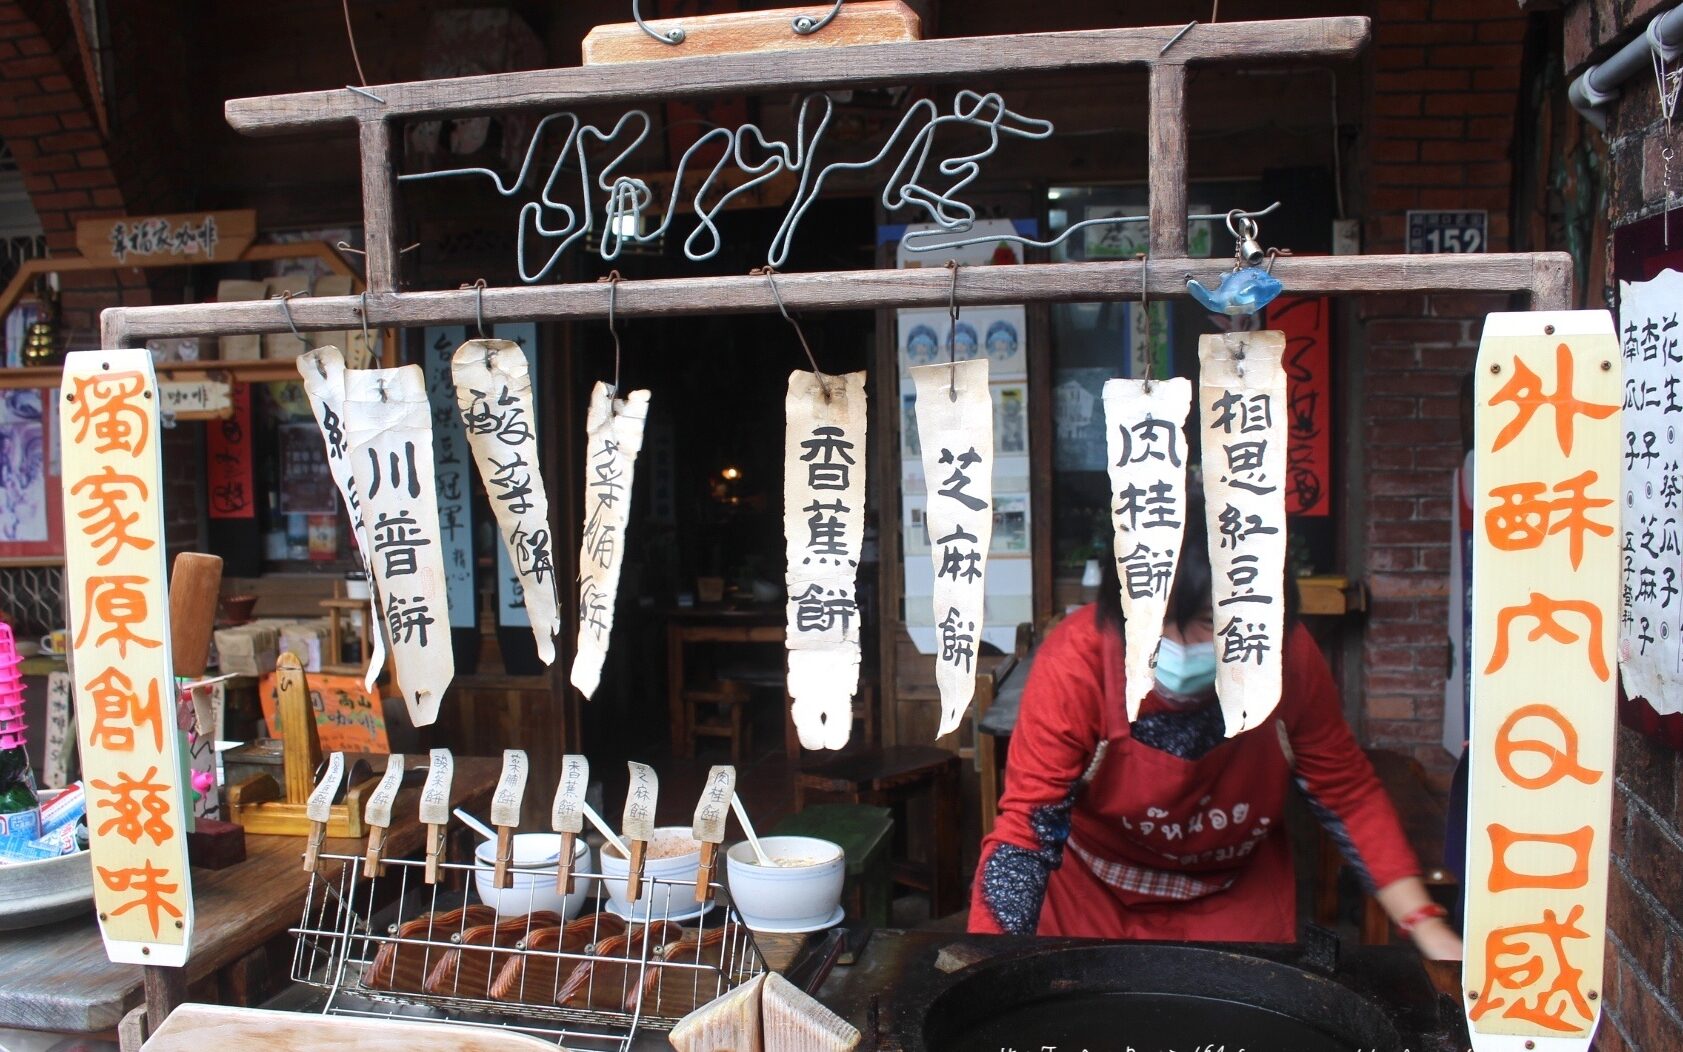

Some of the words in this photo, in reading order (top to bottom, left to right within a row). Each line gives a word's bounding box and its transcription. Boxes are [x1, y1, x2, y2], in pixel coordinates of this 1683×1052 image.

[1427, 228, 1482, 254] 152
[1662, 312, 1683, 415] 花生
[367, 441, 436, 648] 川普餅
[463, 385, 561, 618] 酸菜餅
[791, 426, 858, 634] 香蕉餅
[936, 446, 989, 675] 芝麻餅
[1113, 413, 1182, 601] 肉桂餅
[1209, 392, 1280, 667] 相思紅豆餅
[70, 370, 184, 939] 獨家原創滋味
[1467, 343, 1622, 1033] 外酥內Q口感
[557, 760, 582, 816] 香蕉餅
[629, 764, 651, 823] 芝麻餅
[700, 769, 730, 823] 肉桂餅
